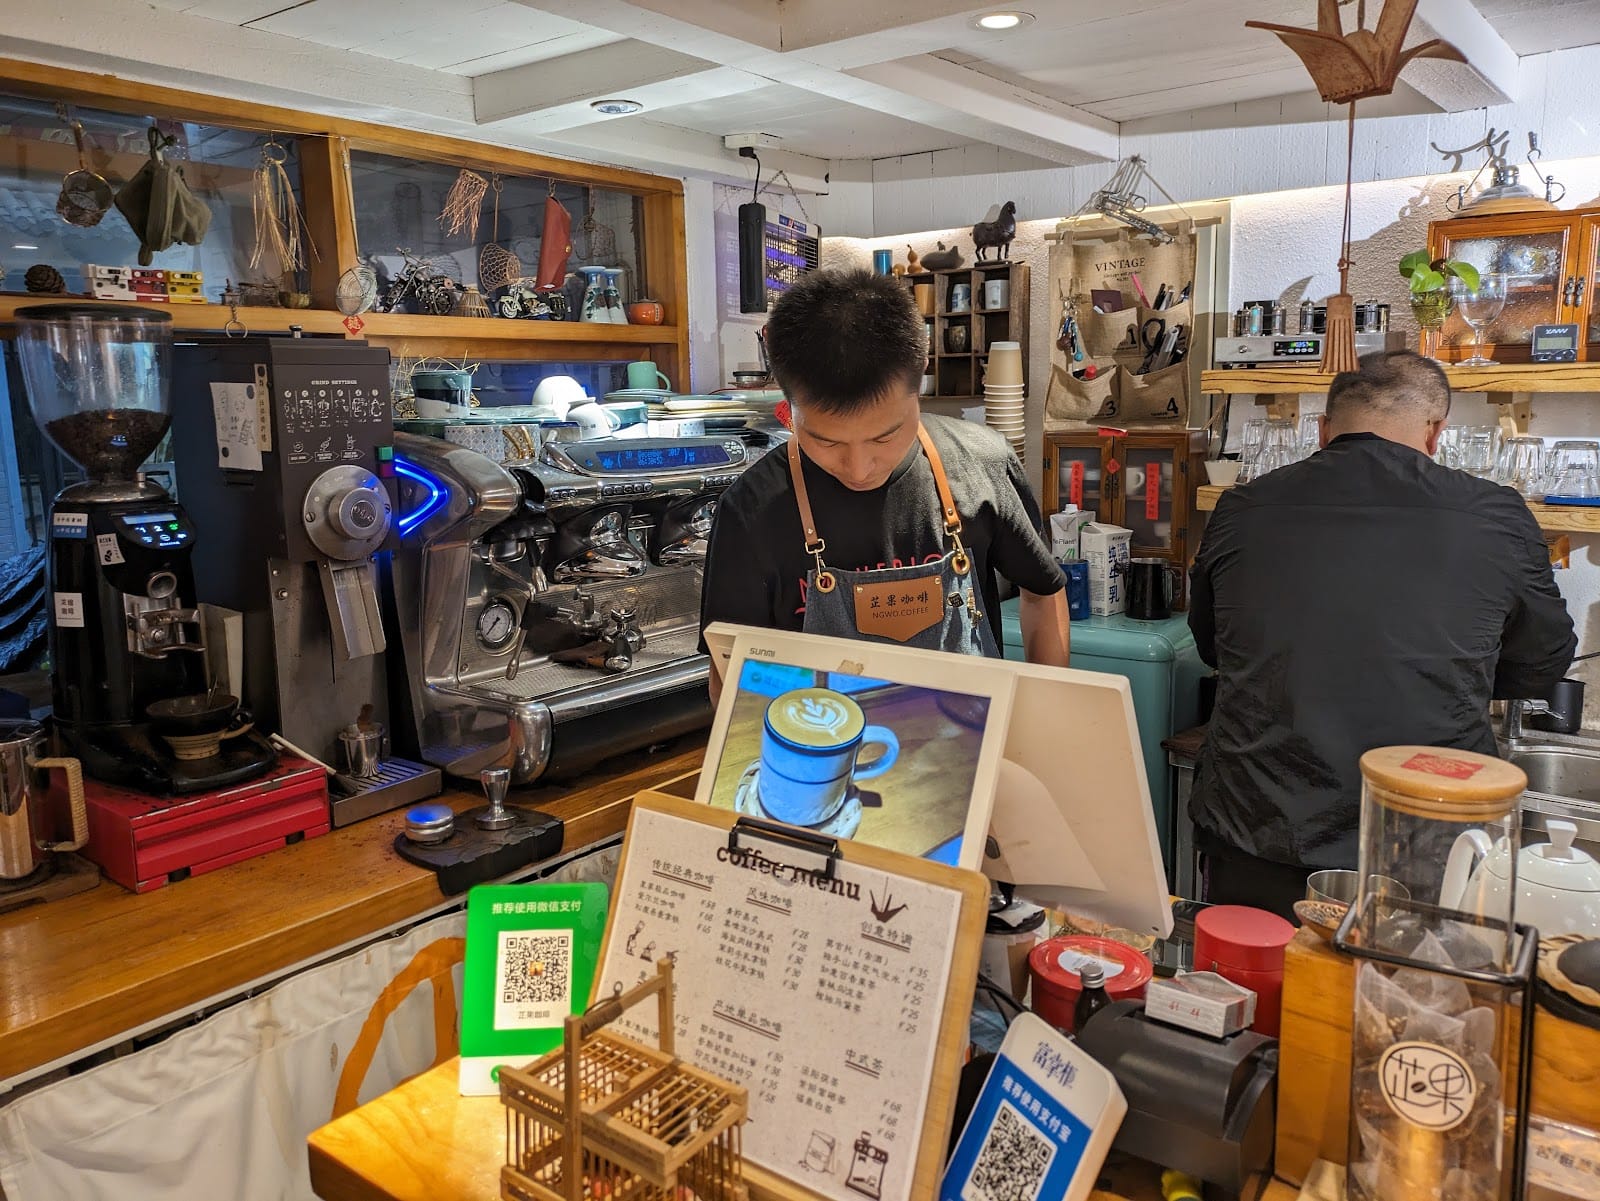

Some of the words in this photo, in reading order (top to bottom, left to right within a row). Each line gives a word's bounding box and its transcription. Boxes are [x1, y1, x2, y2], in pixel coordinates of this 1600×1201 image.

[1095, 257, 1146, 272] VINTAGE
[1127, 328, 1137, 345] 1
[1105, 401, 1116, 416] 3
[1167, 397, 1179, 414] 4
[653, 860, 714, 885] 传统经典咖啡
[717, 846, 785, 879] coffee
[790, 866, 861, 901] menu
[492, 901, 582, 914] 推荐使用微信支付
[747, 888, 793, 909] 风味咖啡
[862, 922, 913, 946] 创意特调
[846, 1050, 883, 1071] 中式茶
[1032, 1041, 1079, 1089] 富掌柜
[1001, 1074, 1072, 1143] 推荐使用支付宝
